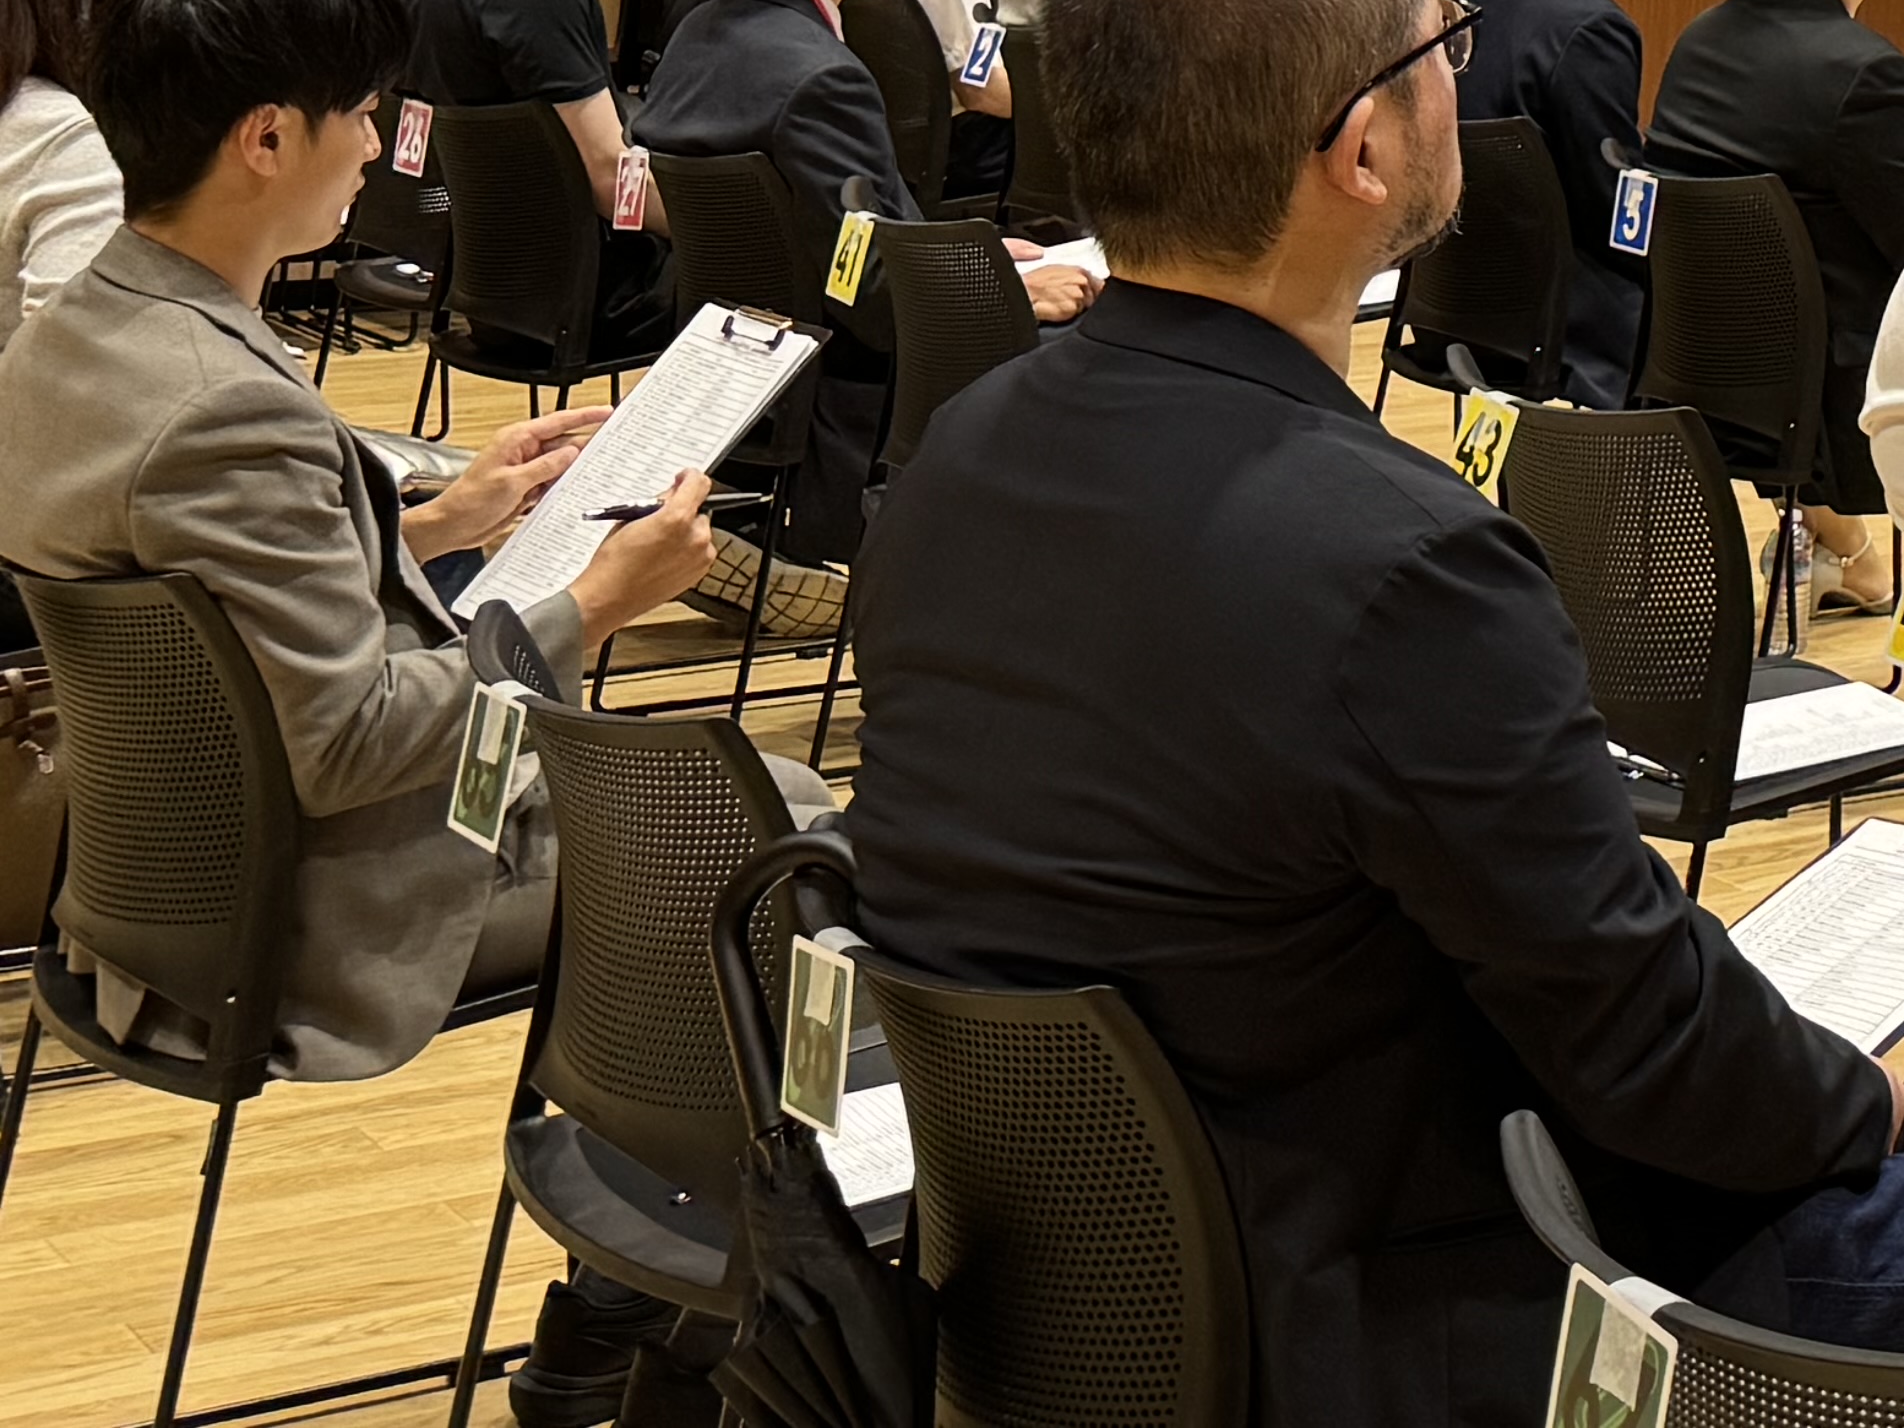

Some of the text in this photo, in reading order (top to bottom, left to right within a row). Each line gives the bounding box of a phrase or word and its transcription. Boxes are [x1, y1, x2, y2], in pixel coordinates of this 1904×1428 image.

[970, 39, 992, 77] 2
[617, 166, 645, 217] 27
[836, 229, 863, 288] 41
[1456, 411, 1502, 487] 43
